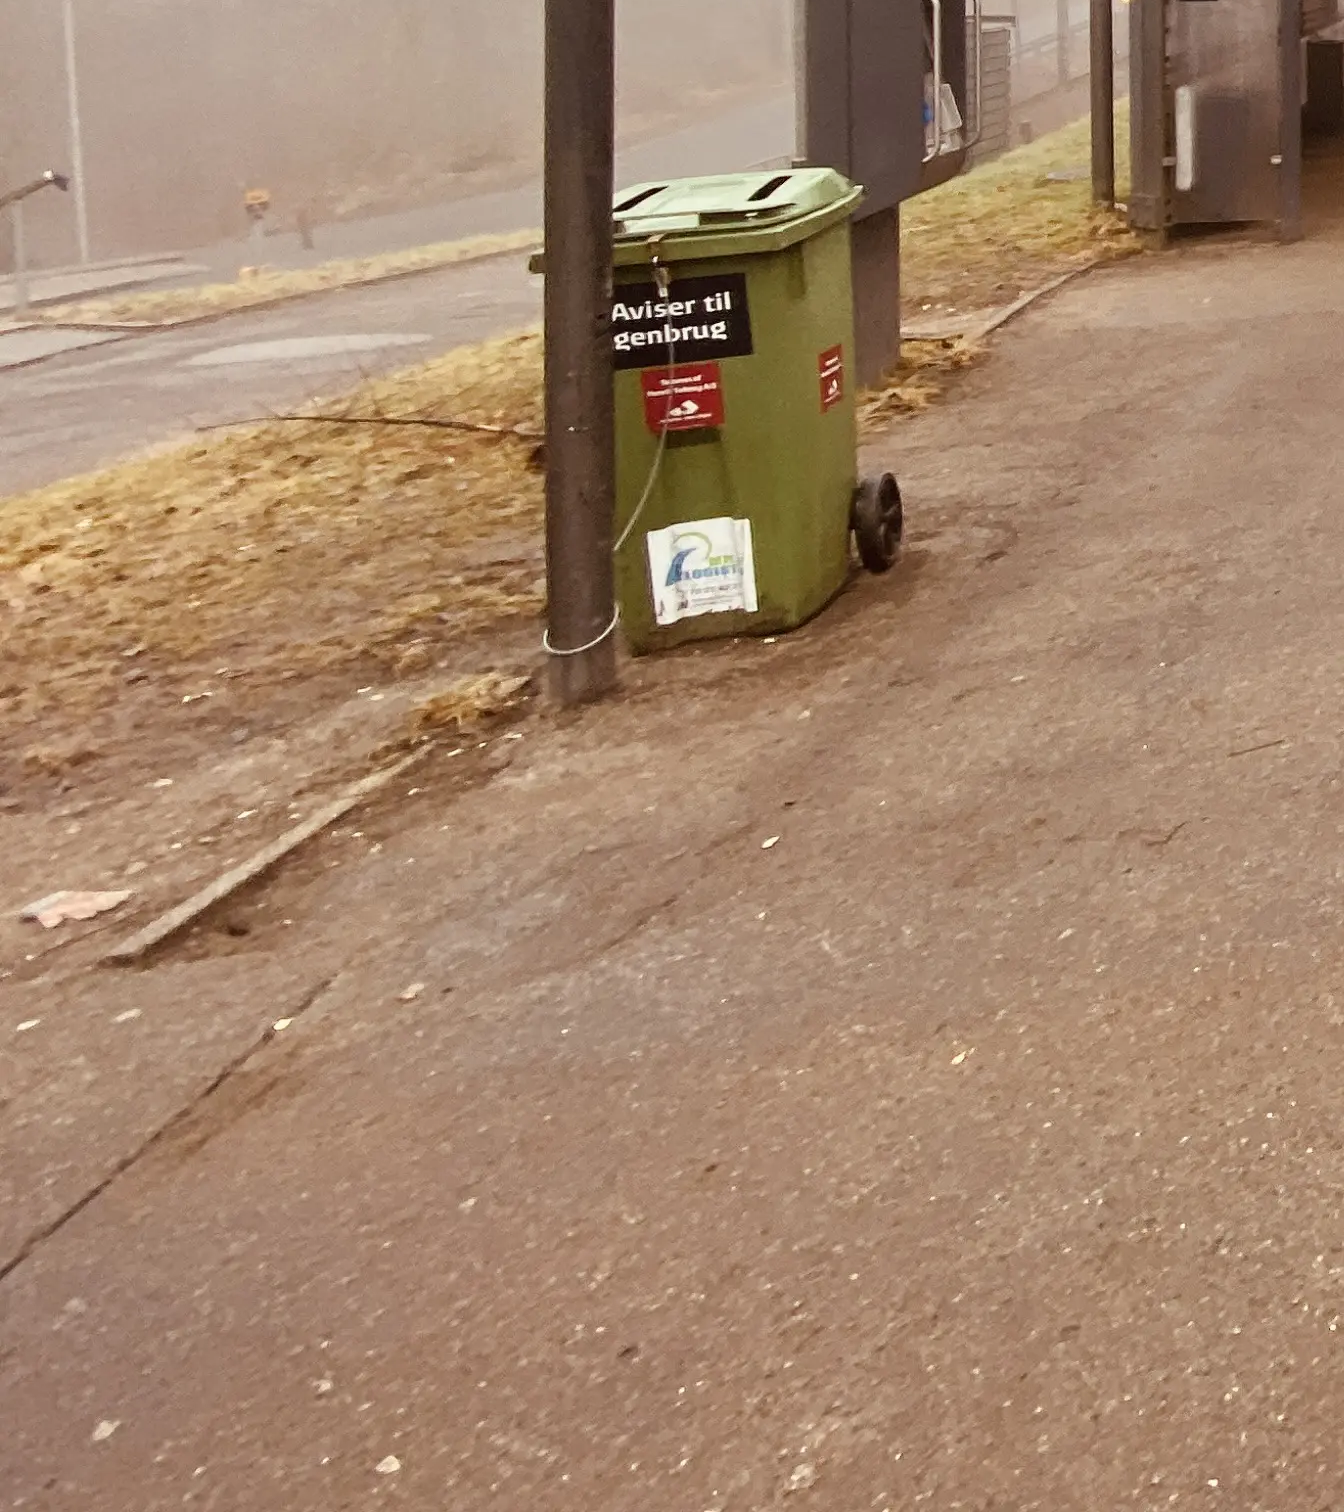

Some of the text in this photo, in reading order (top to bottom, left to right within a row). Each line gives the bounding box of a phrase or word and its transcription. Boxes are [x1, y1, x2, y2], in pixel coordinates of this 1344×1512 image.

[611, 291, 732, 322] Aviser til
[613, 320, 729, 351] genbrug
